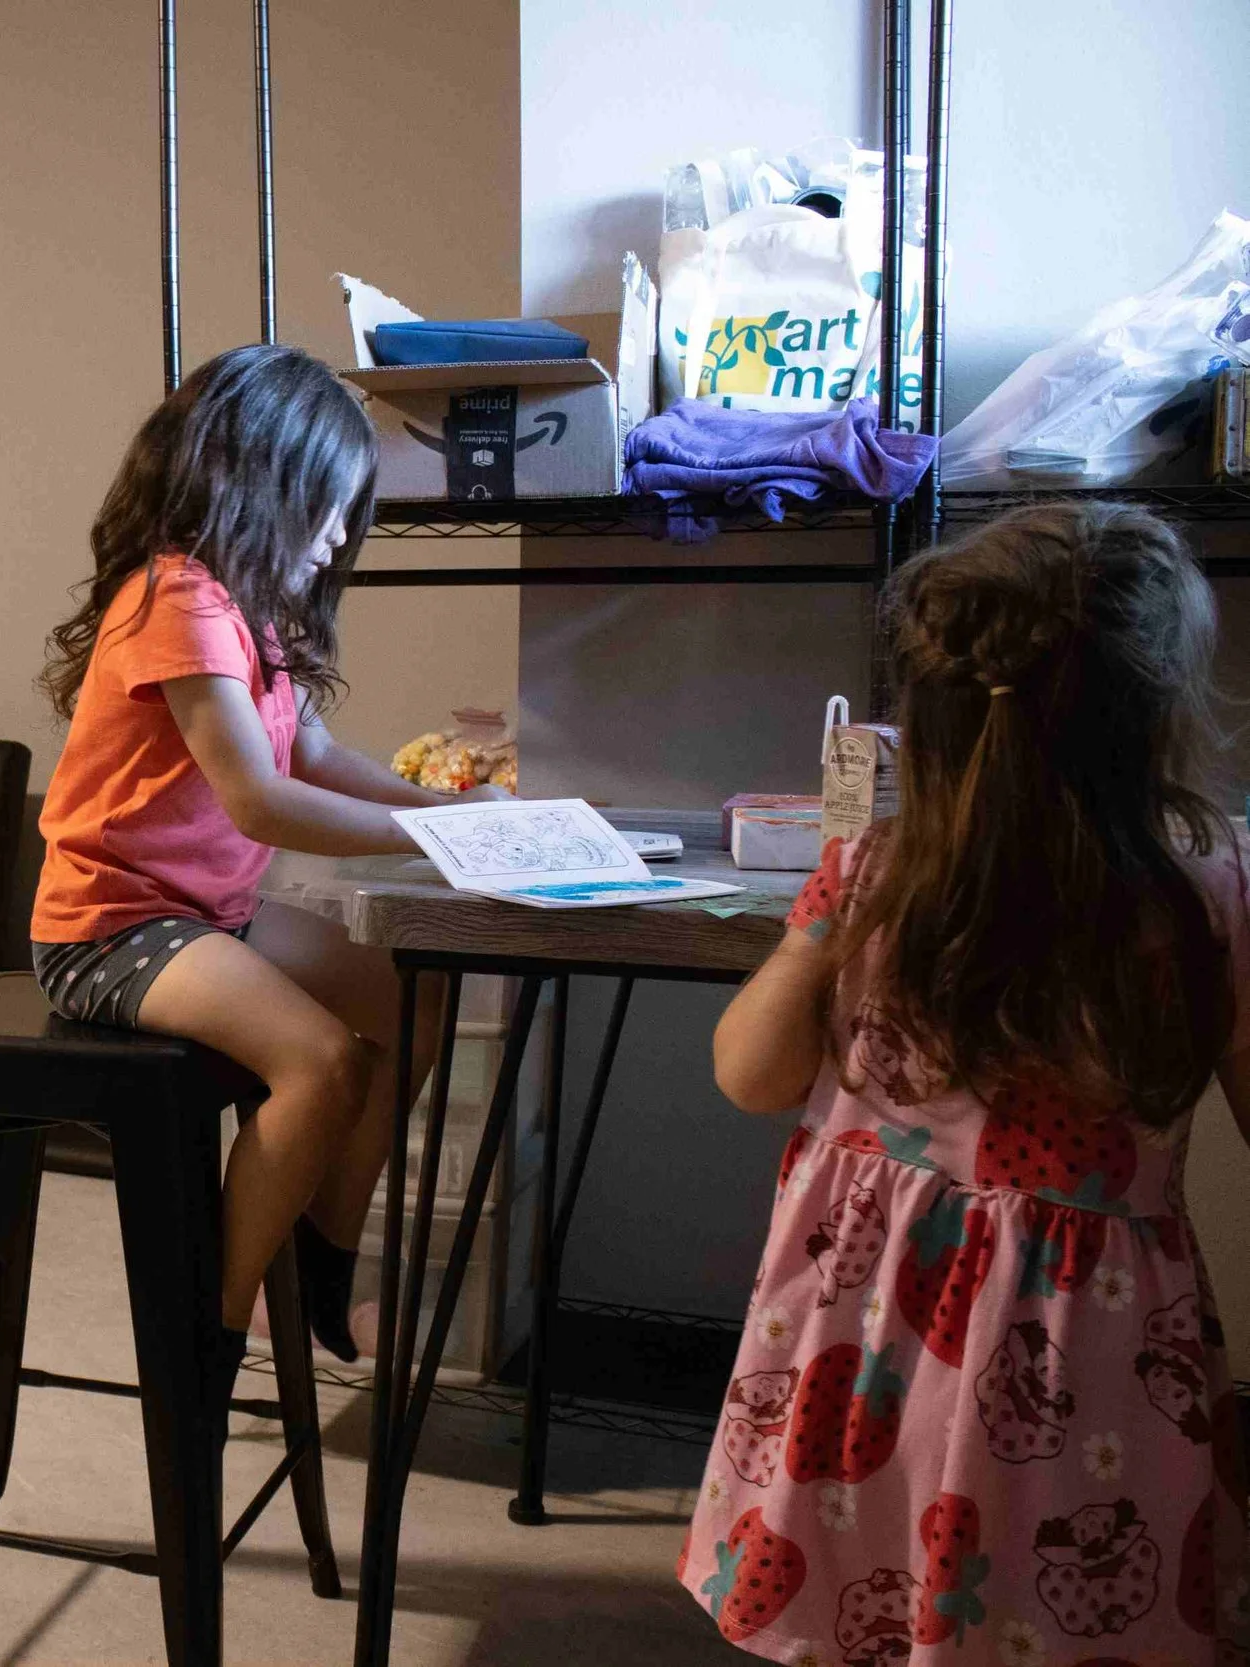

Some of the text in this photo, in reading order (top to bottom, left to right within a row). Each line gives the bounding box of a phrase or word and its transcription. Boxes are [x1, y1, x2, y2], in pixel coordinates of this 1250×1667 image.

[460, 395, 510, 414] prime
[830, 754, 872, 769] ARDMORE
[824, 800, 849, 811] APPLE
